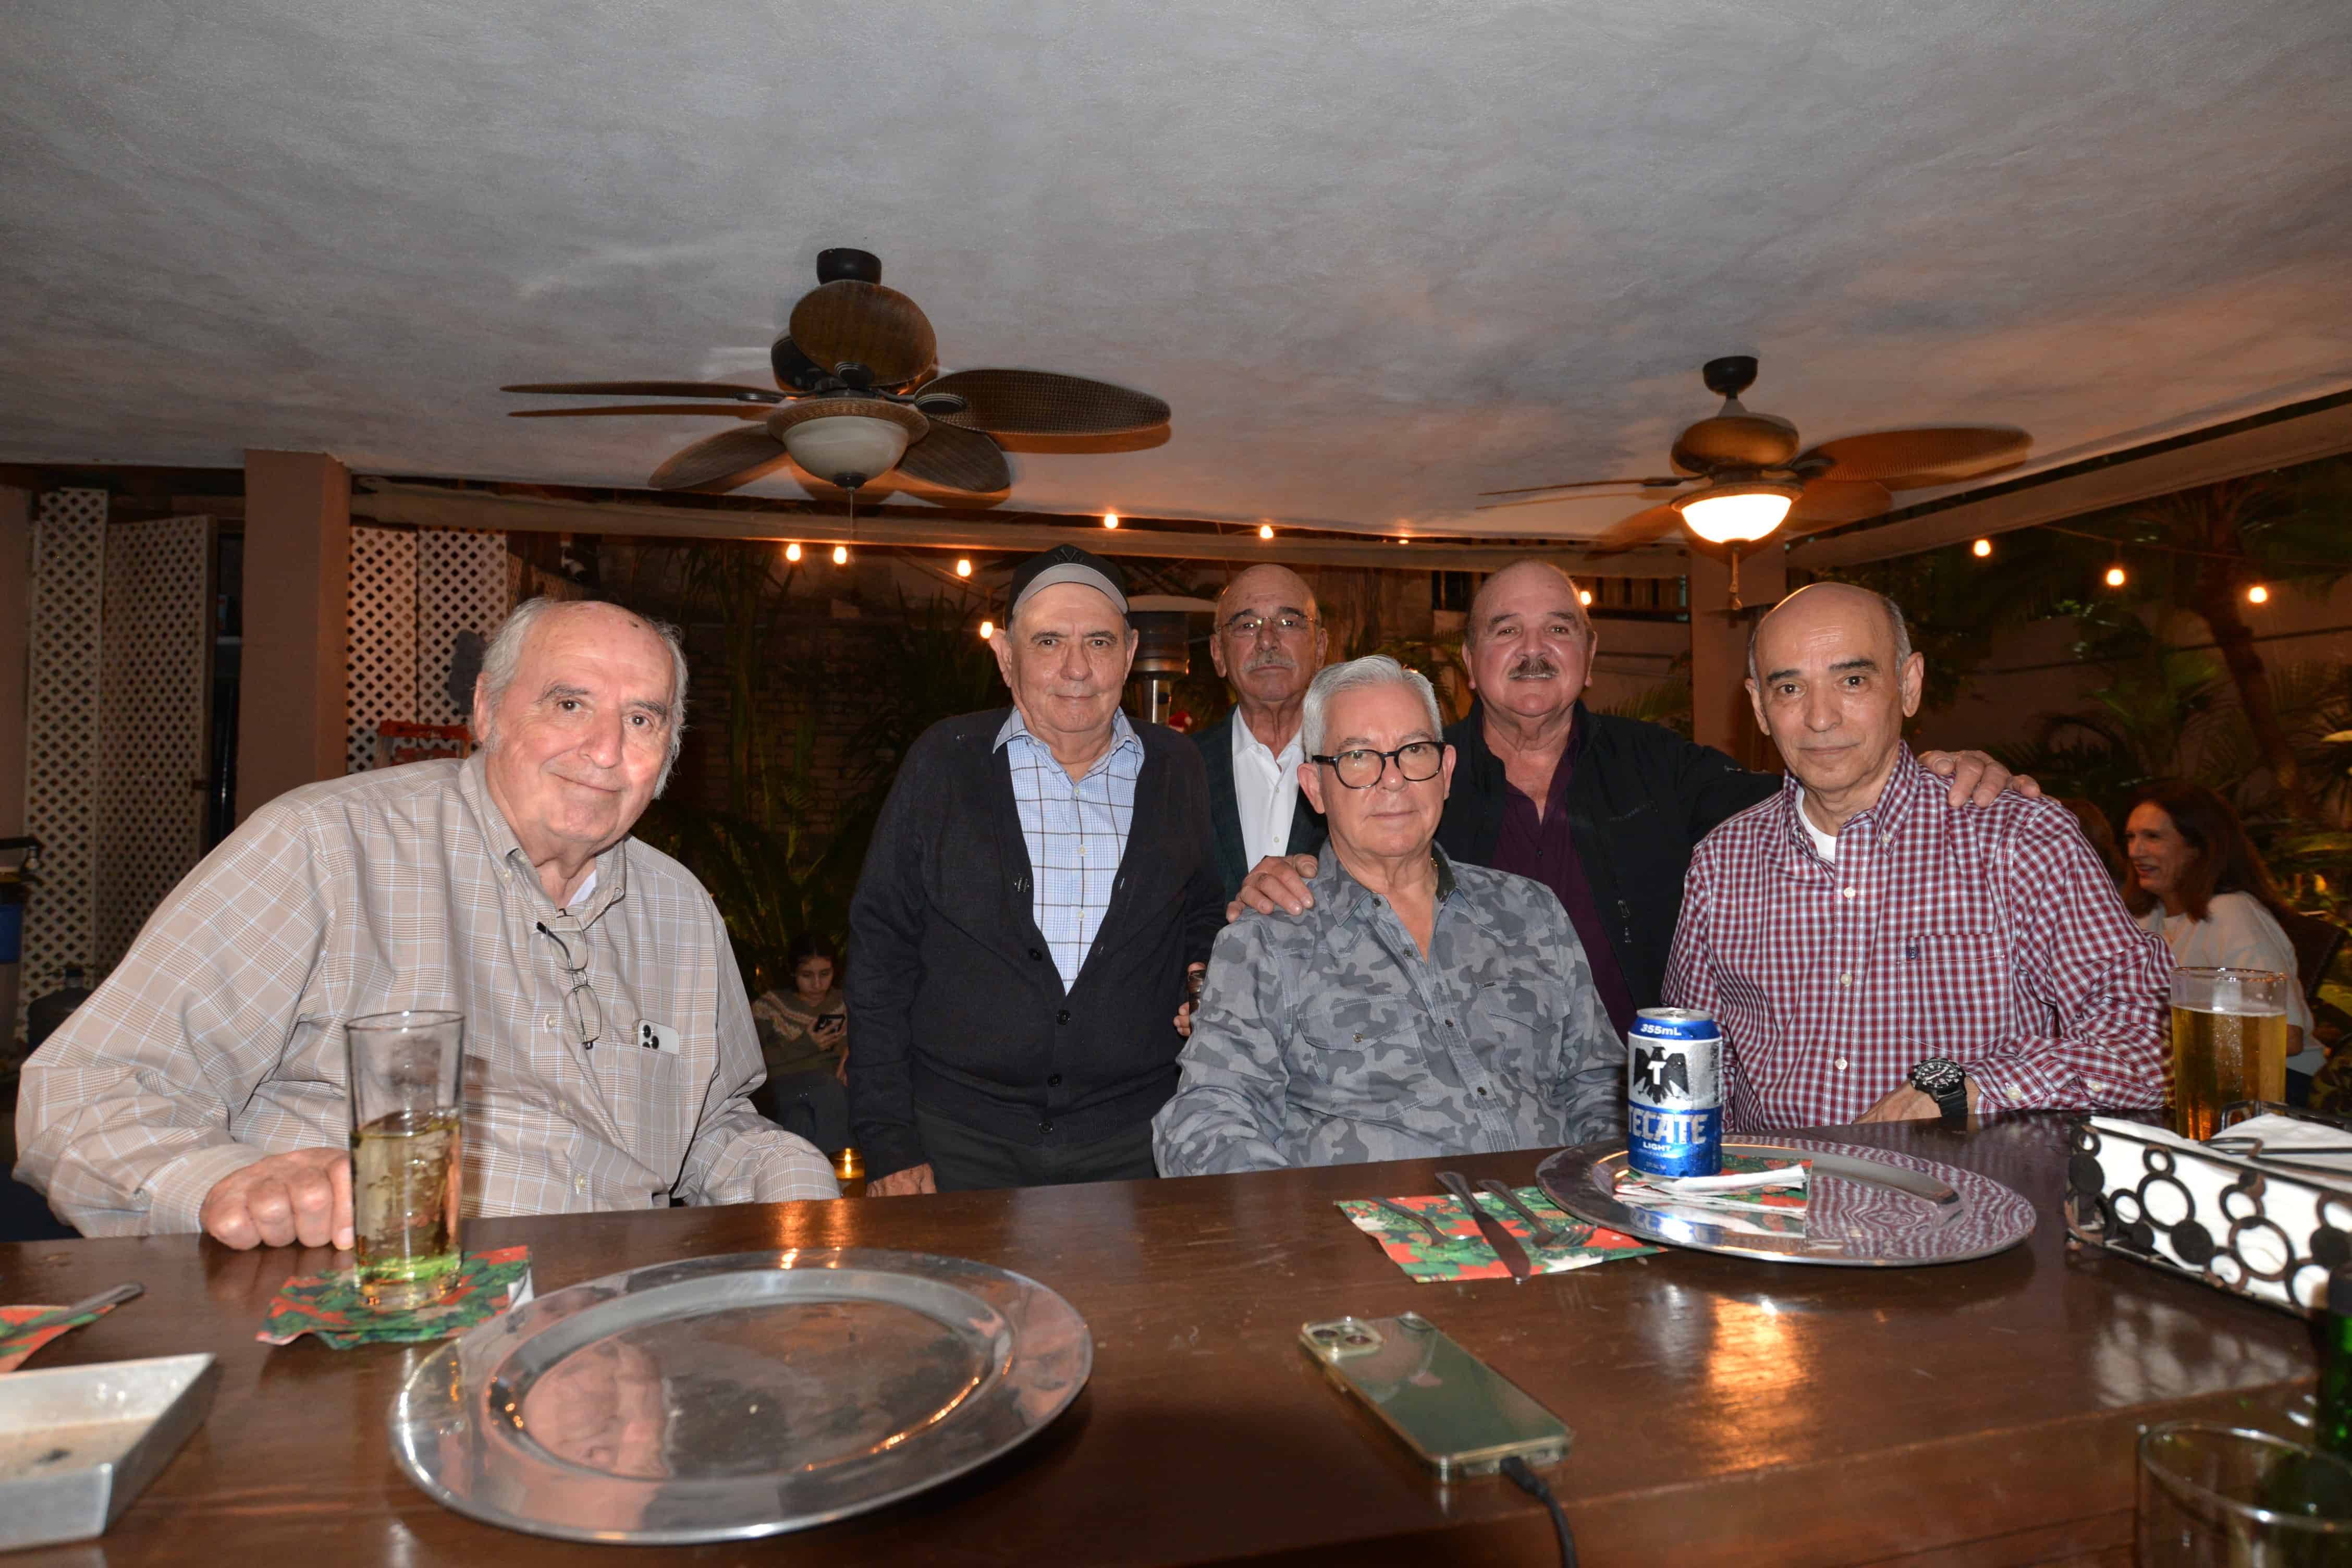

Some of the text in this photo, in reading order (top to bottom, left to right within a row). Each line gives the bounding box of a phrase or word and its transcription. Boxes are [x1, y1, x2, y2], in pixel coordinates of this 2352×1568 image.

[1640, 1023, 1682, 1036] 355mL
[1647, 1060, 1667, 1085] T
[1643, 1142, 1672, 1152] LIGHT
